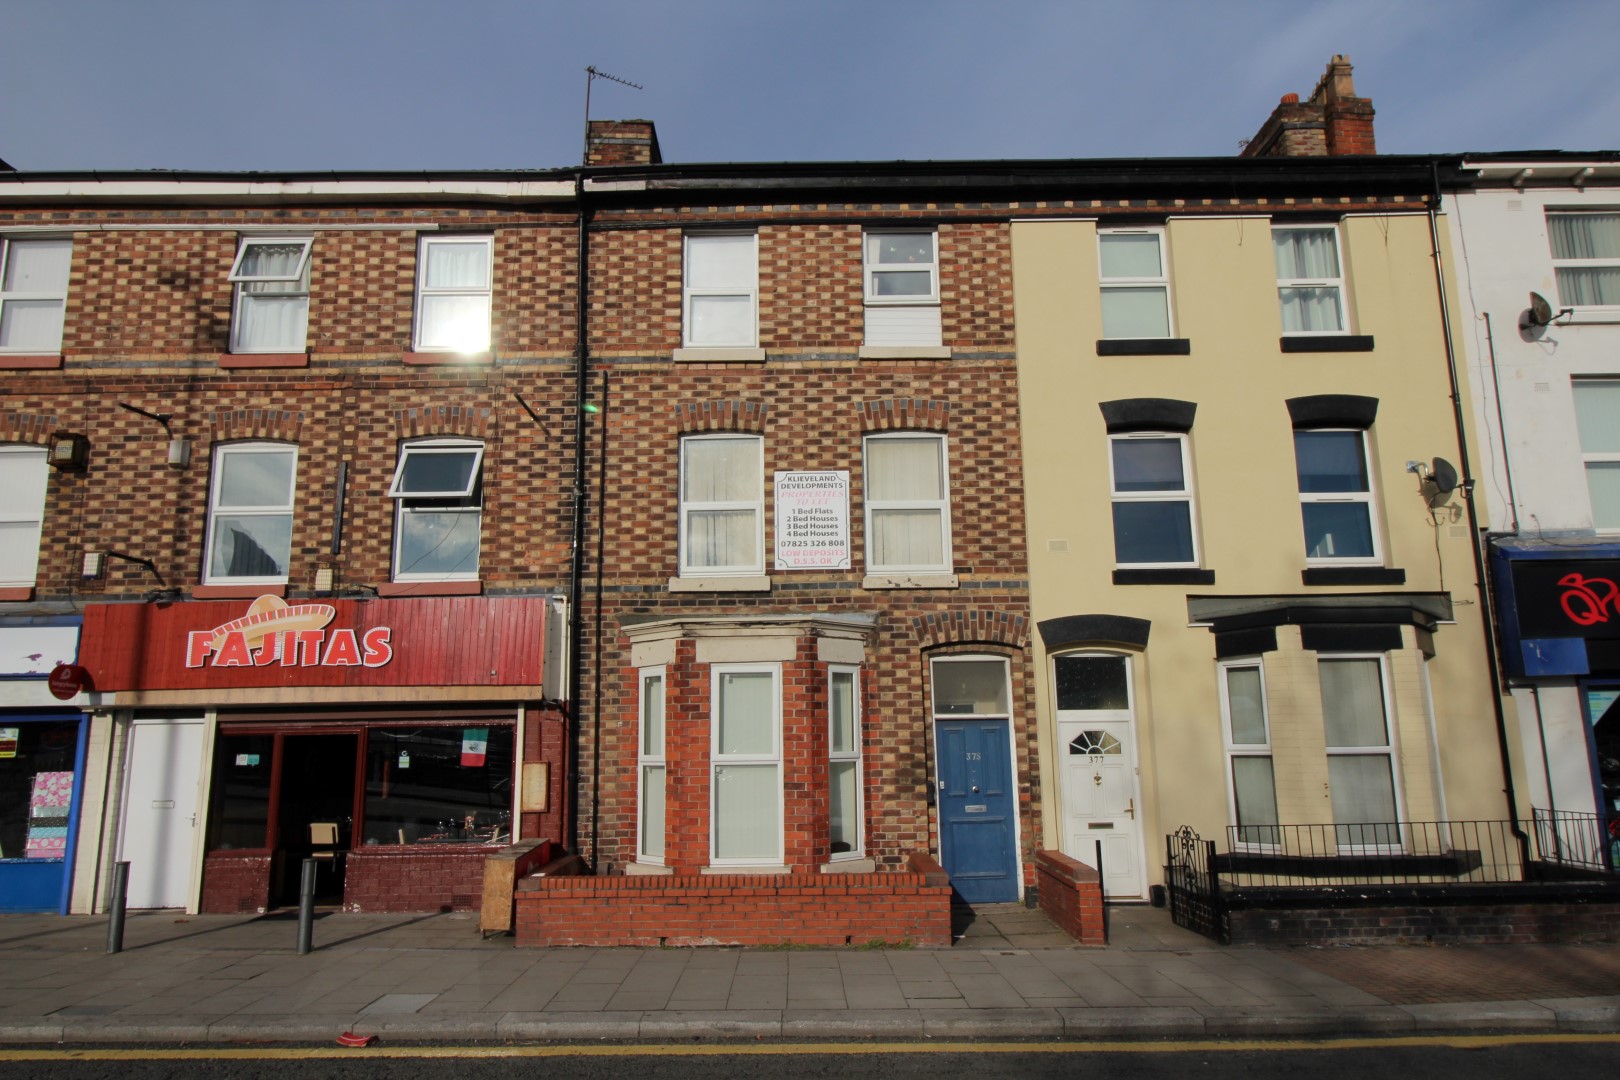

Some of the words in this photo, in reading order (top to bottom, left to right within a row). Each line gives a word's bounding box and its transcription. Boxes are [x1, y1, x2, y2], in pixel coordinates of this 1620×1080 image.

[781, 490, 844, 498] PROPERTIES
[186, 626, 394, 668] FAJITAS
[965, 752, 981, 760] 375
[1088, 755, 1104, 763] 377
